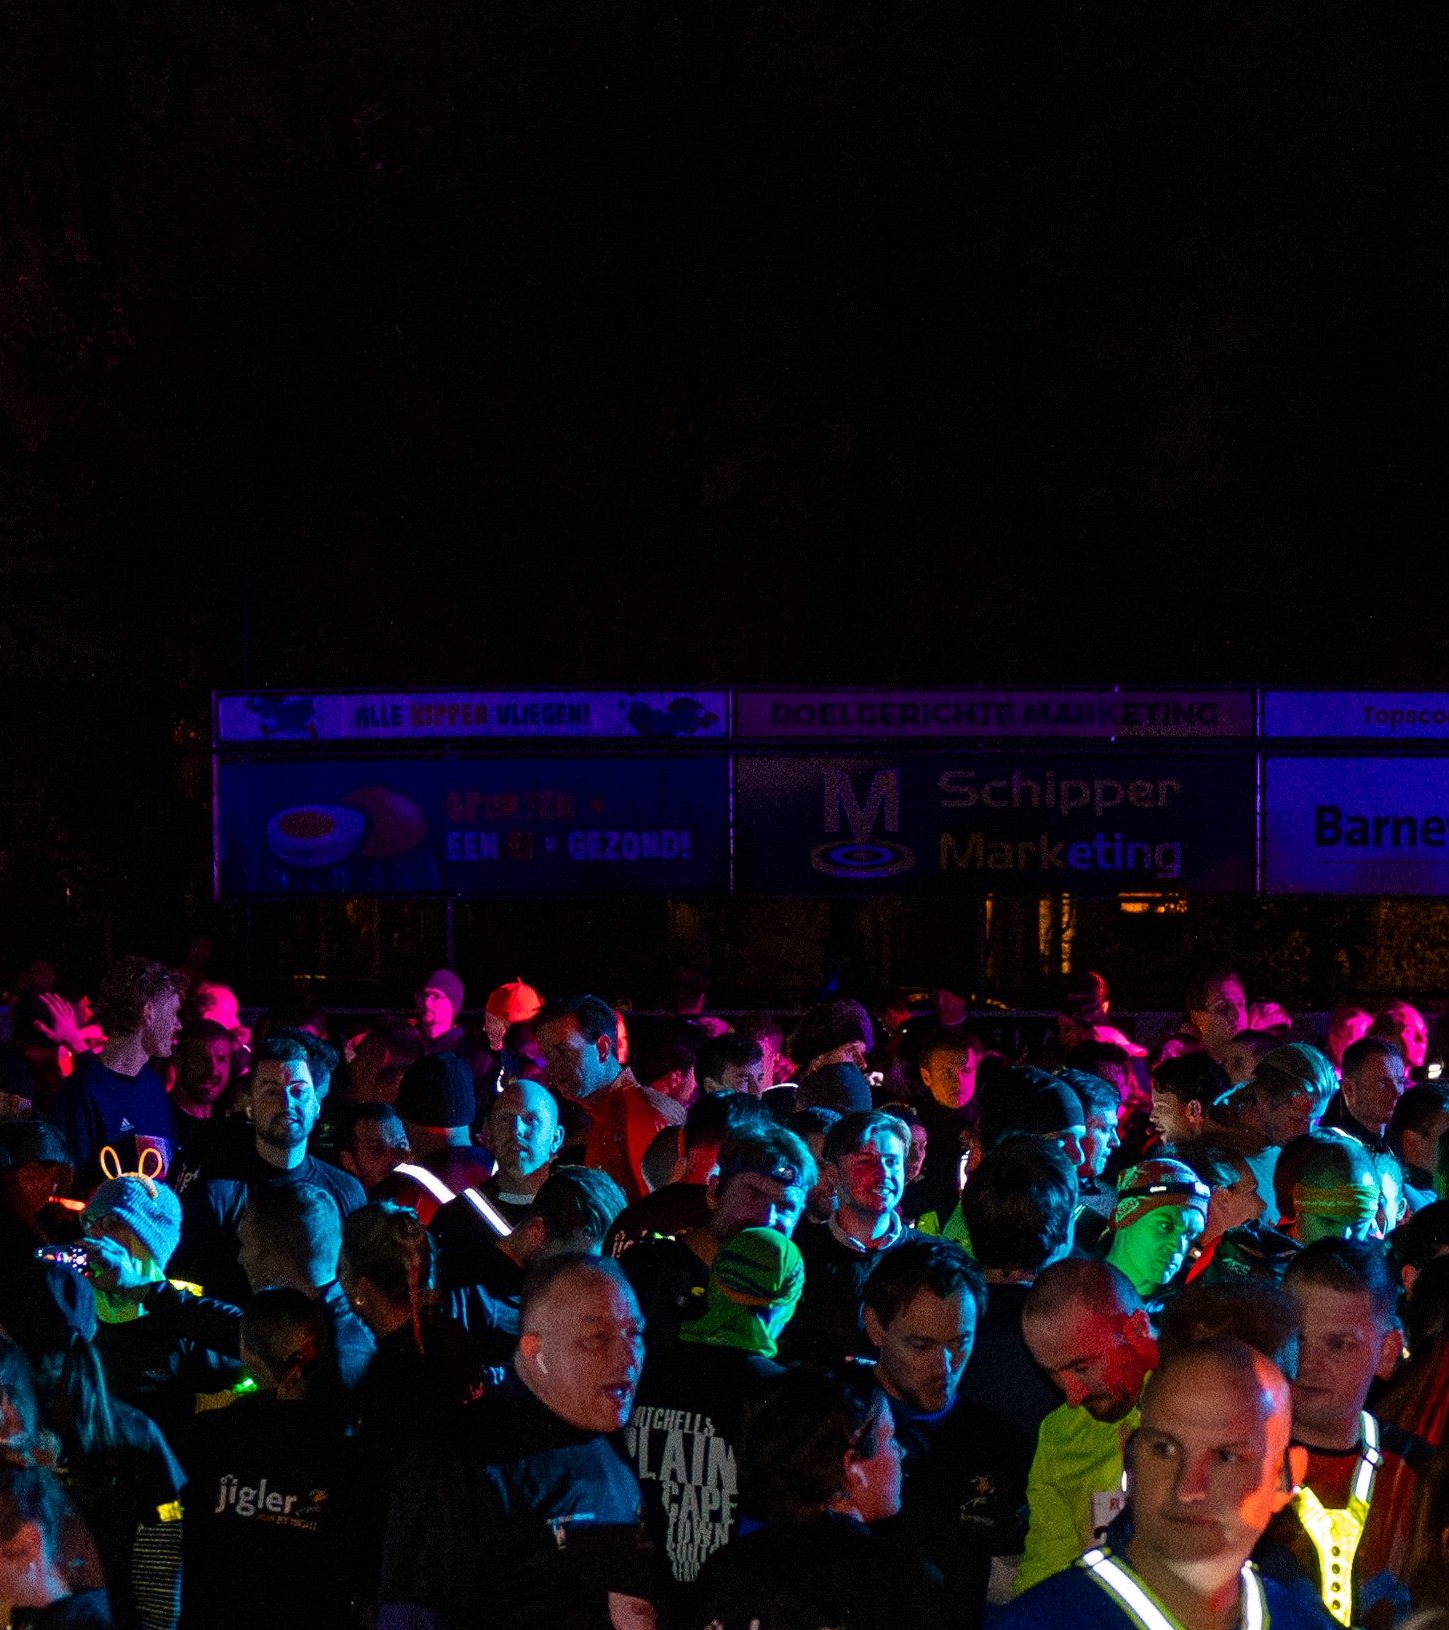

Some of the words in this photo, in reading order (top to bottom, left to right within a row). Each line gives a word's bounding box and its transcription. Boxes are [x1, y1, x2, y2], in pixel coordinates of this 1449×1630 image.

[770, 703, 1019, 727] DOELGERICHTE
[1023, 701, 1219, 726] MARKETING
[937, 770, 1182, 816] Schipper
[568, 831, 692, 861] GEZOND!
[938, 832, 1182, 880] Marketing
[214, 1474, 298, 1517] jigler
